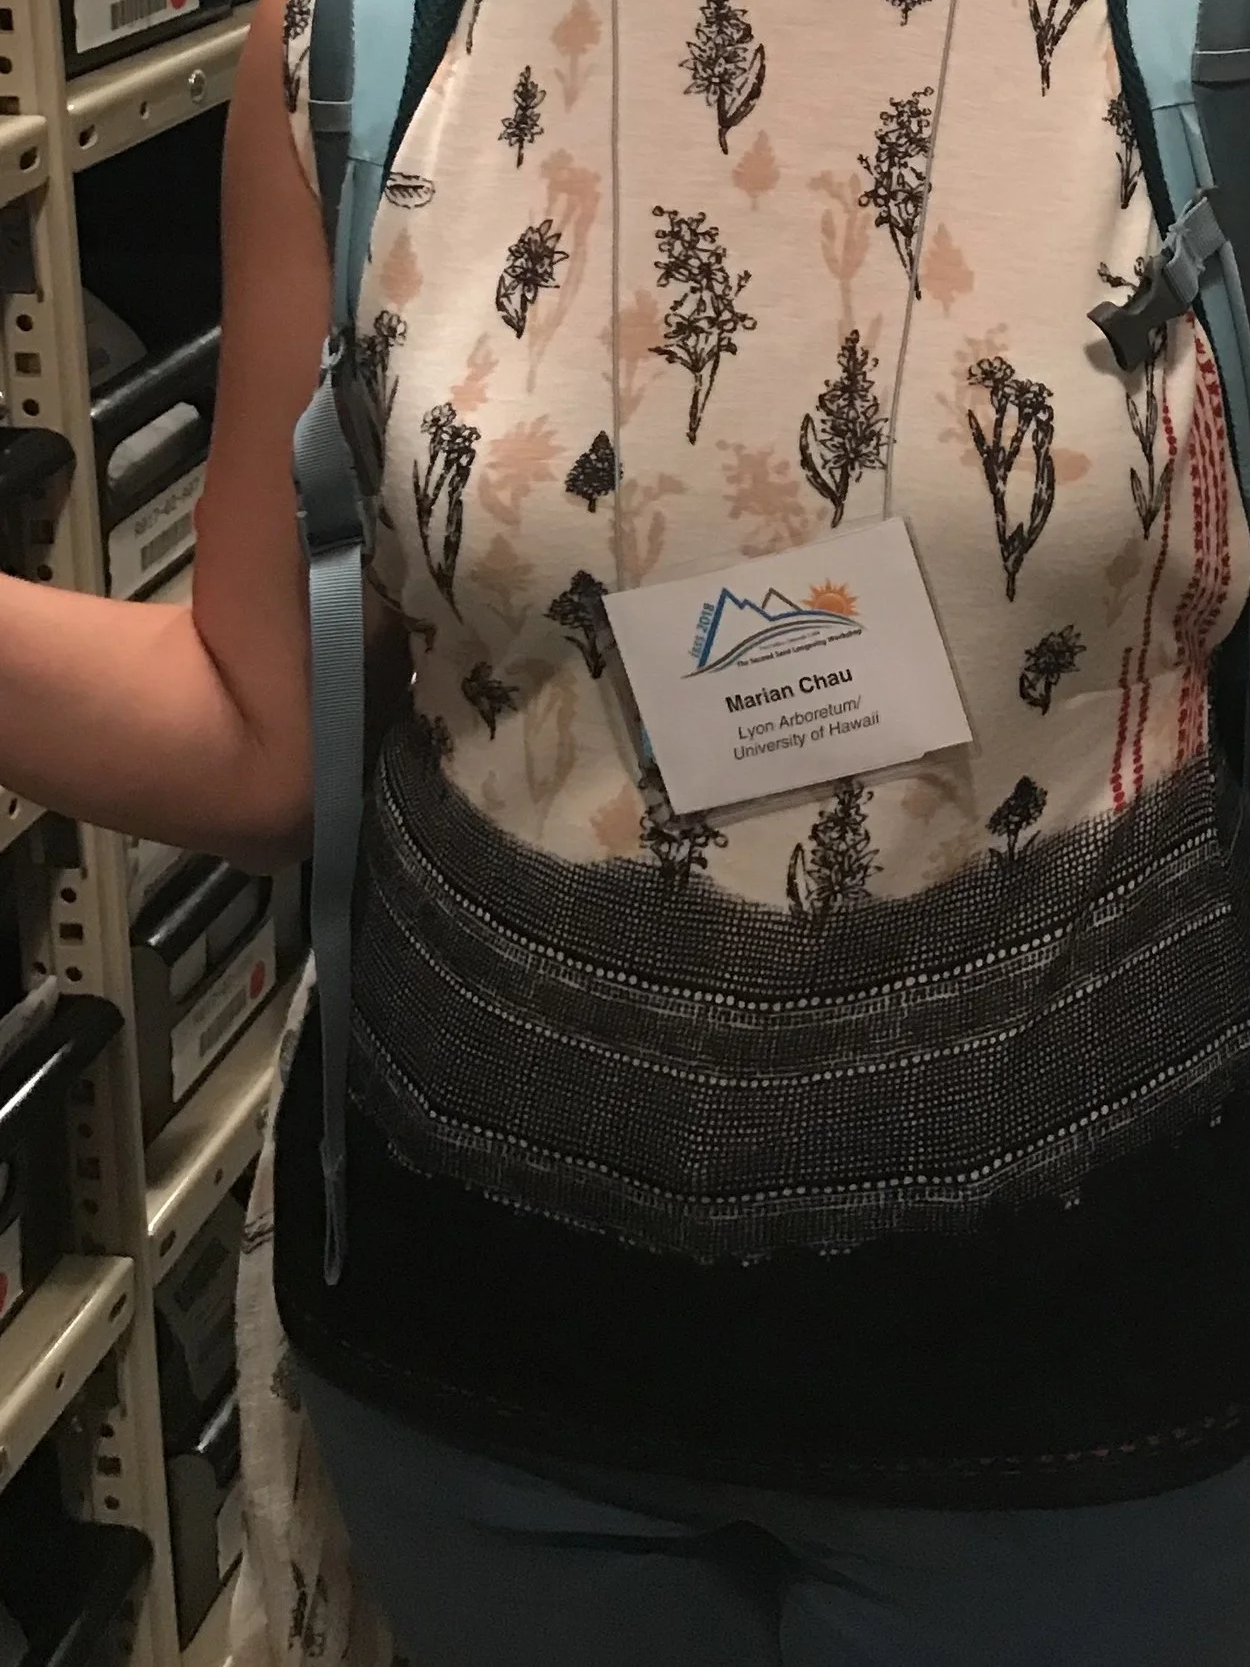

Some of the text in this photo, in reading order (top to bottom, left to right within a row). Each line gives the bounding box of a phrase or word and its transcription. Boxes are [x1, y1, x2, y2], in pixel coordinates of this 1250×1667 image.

[725, 668, 853, 713] Marian Chau
[734, 710, 880, 760] University of Hawaii
[738, 694, 861, 740] Lyon Arboretum/
